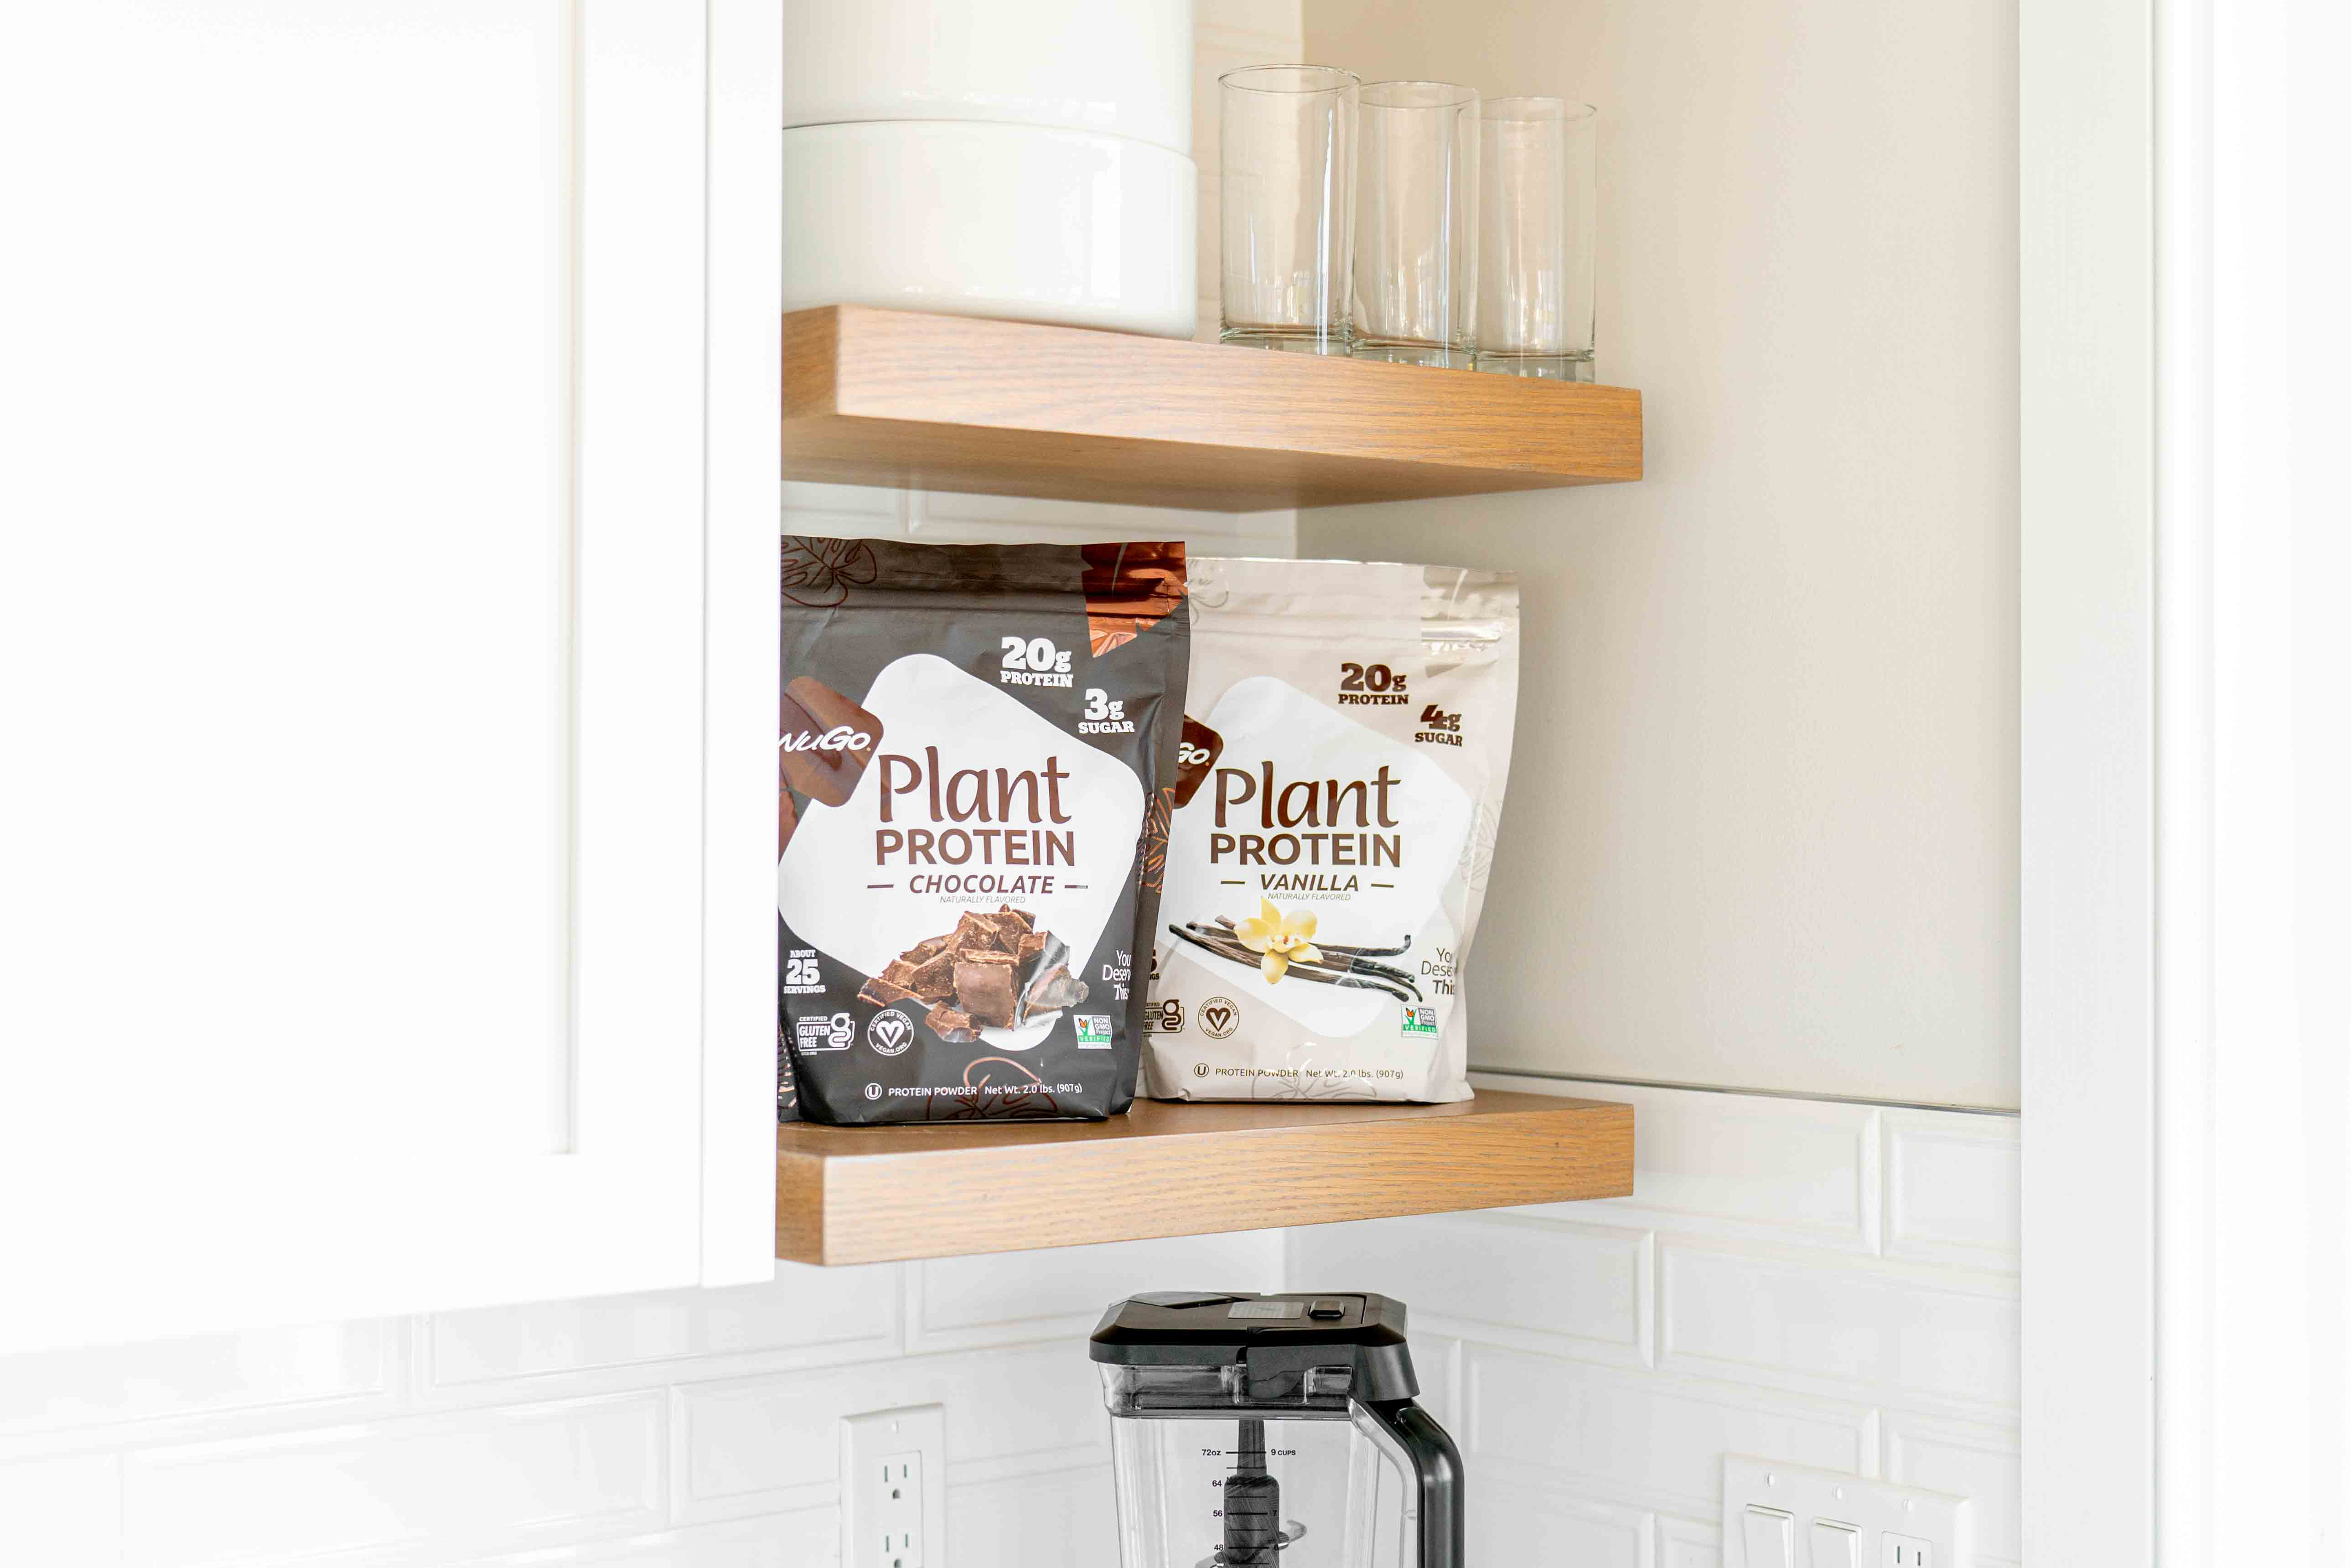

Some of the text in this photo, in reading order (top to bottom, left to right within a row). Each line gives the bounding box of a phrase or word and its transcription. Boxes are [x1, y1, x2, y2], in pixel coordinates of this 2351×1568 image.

[1001, 637, 1071, 673] 20g
[1000, 671, 1074, 688] PROTEIN
[1341, 662, 1407, 692] 20g
[1084, 688, 1124, 721] 3g
[1338, 693, 1409, 705] PROTEIN
[1420, 704, 1462, 732] 4g
[1078, 720, 1135, 734] SUGAR
[1415, 732, 1463, 747] SUGAR
[878, 746, 1072, 823] Plant
[1215, 761, 1401, 829] Plant
[876, 828, 1075, 866] PROTEIN
[1210, 833, 1400, 868] PROTEIN
[910, 875, 1055, 894] CHOCOLATE
[1261, 874, 1358, 891] VANILLA
[1268, 892, 1310, 900] NATURALLY
[790, 949, 816, 958] ABOUT
[1116, 950, 1131, 967] You
[1436, 947, 1452, 963] Yo
[786, 959, 821, 985] 25
[783, 985, 826, 994] SERVINGS
[1200, 999, 1237, 1016] CERTIFIED VEGAN
[870, 1011, 911, 1031] CERTIFIED VEGAN
[799, 1025, 831, 1037] GLUTEN
[800, 1036, 817, 1048] FREE
[1215, 1068, 1255, 1076] PROTEIN
[1359, 1070, 1373, 1078] lbs.
[1376, 1070, 1403, 1080] (907g)
[889, 1087, 932, 1097] PROTEIN
[934, 1086, 978, 1096] POWDER
[984, 1086, 1003, 1094] Net
[1005, 1086, 1020, 1094] Wt.
[1023, 1085, 1037, 1093] 2.0
[1040, 1084, 1055, 1093] lbs.
[1057, 1083, 1082, 1093] (907g)
